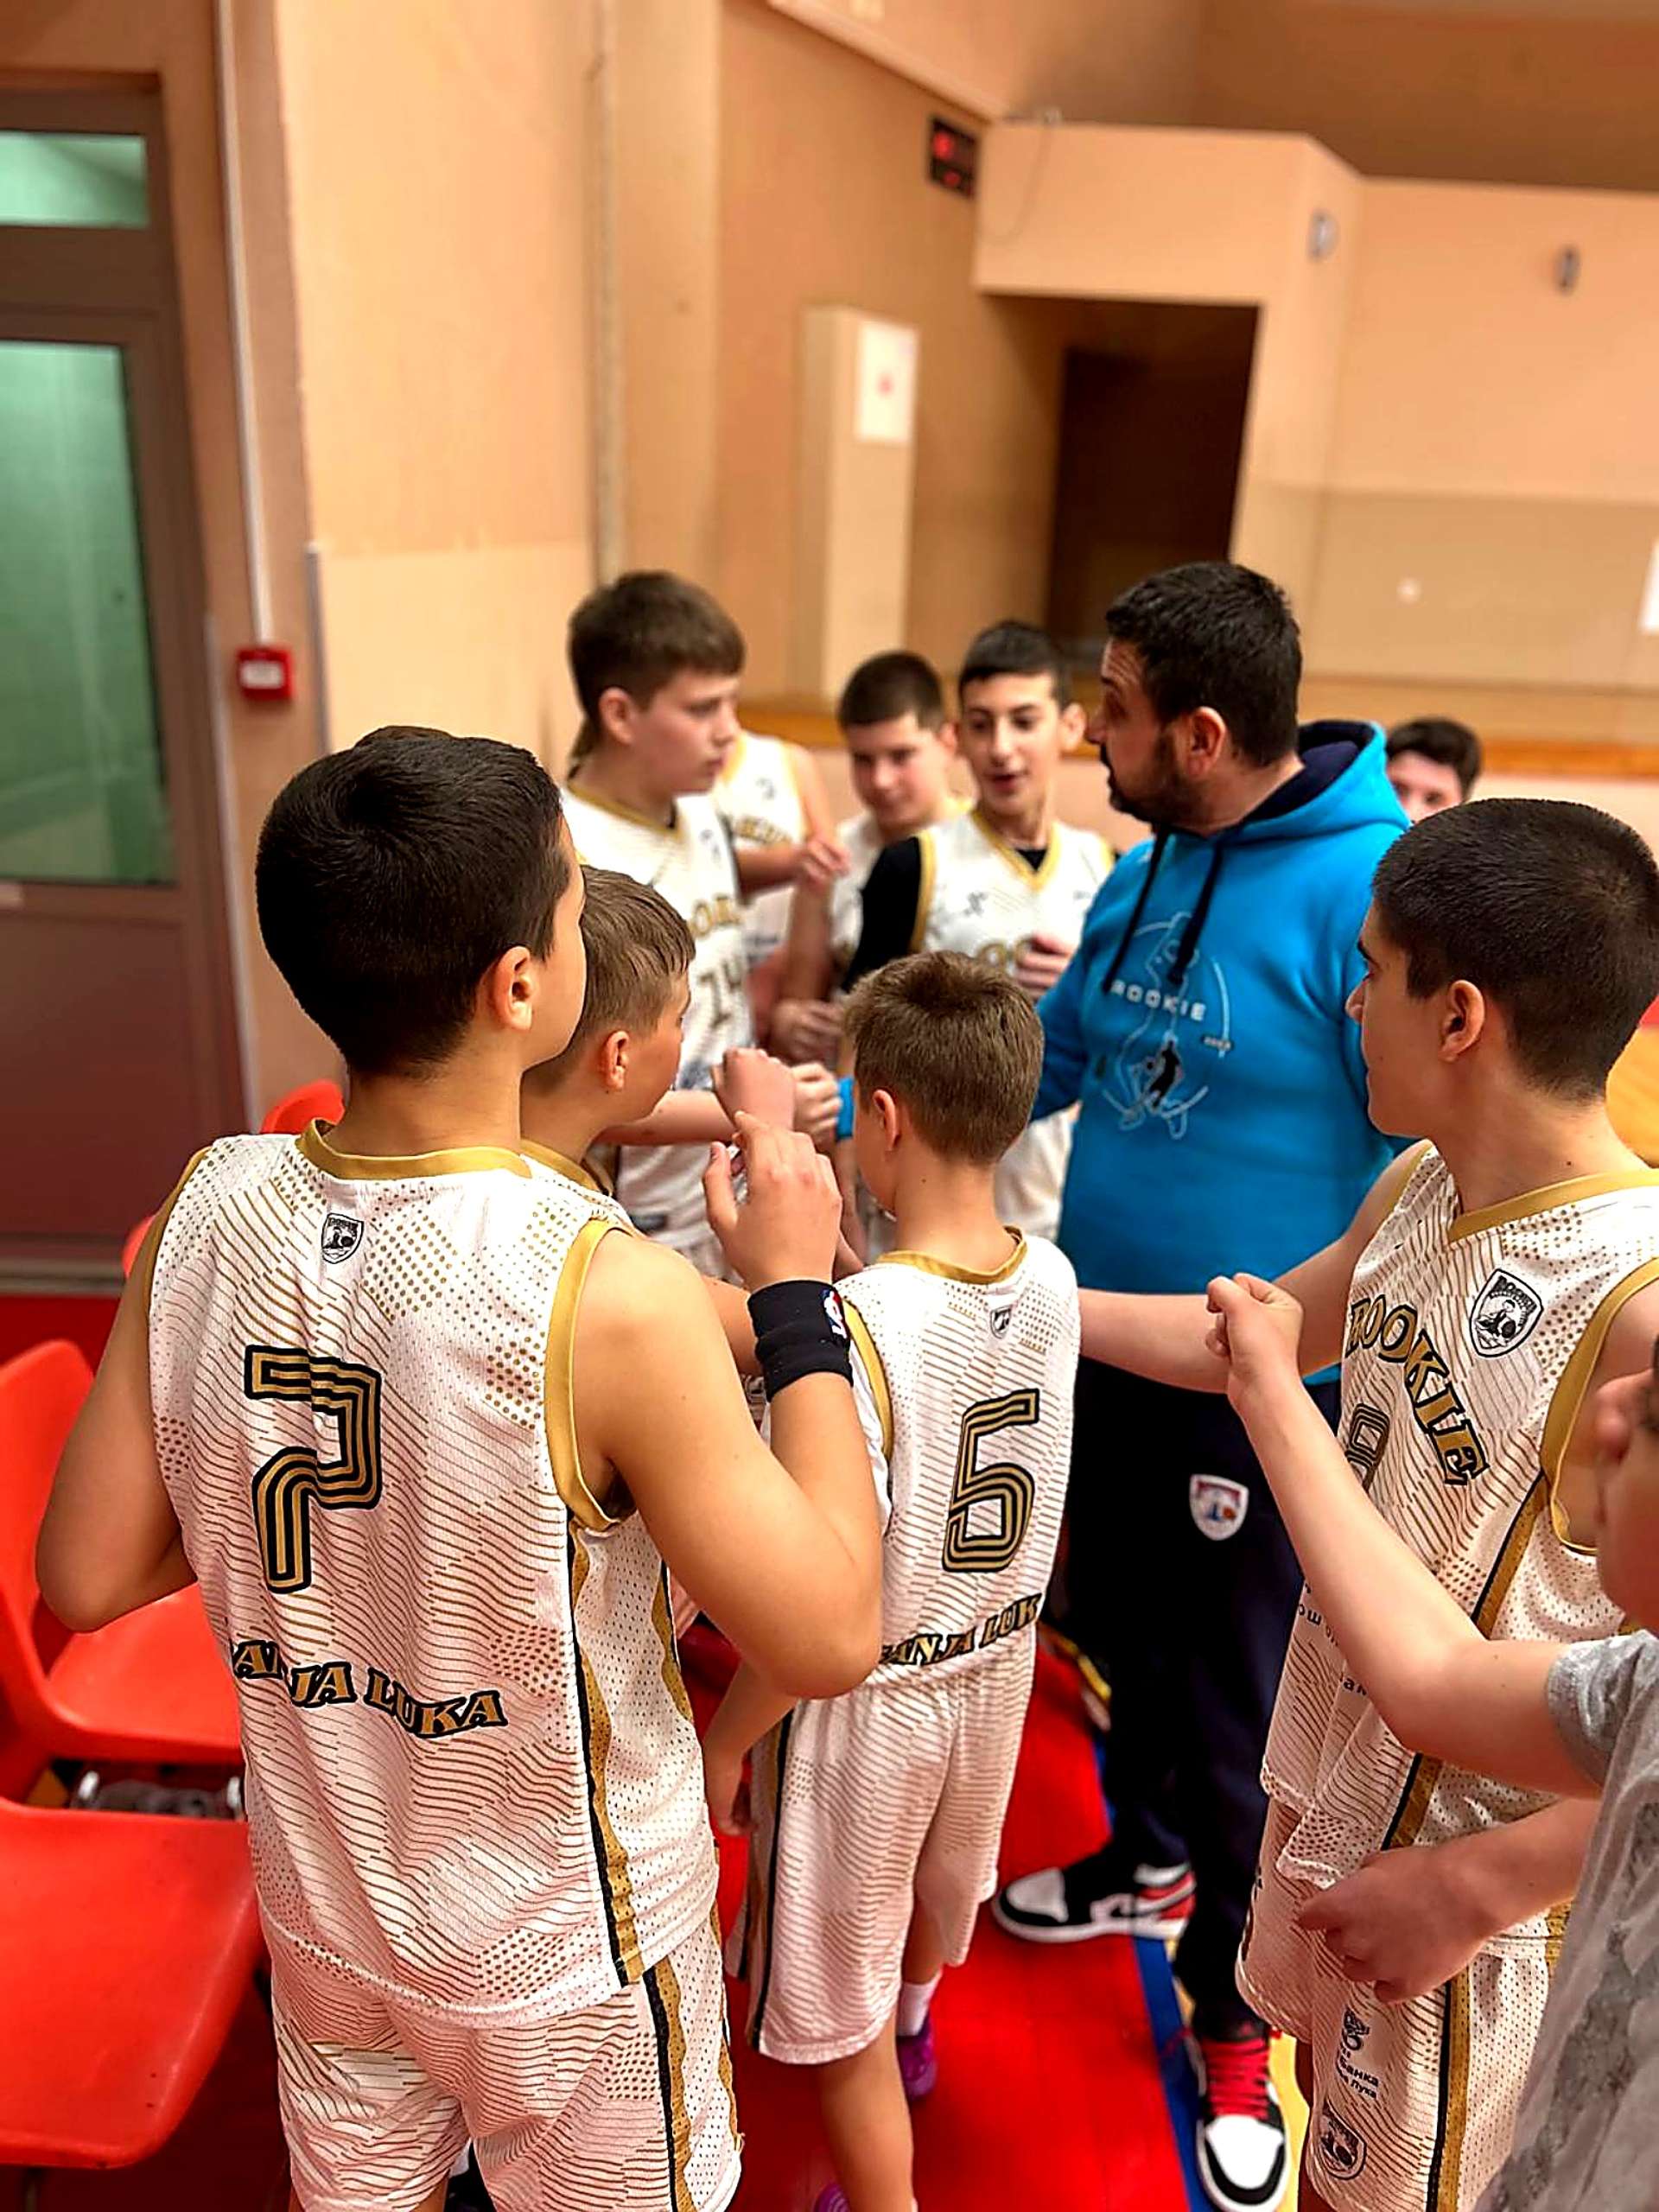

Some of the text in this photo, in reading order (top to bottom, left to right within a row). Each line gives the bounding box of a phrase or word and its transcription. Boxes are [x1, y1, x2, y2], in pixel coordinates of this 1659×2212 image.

[1344, 1294, 1491, 1485] ROOKIE
[942, 1388, 1039, 1573] 6
[229, 1640, 509, 1738] AJA LUKA
[978, 1592, 1043, 1649] LUK
